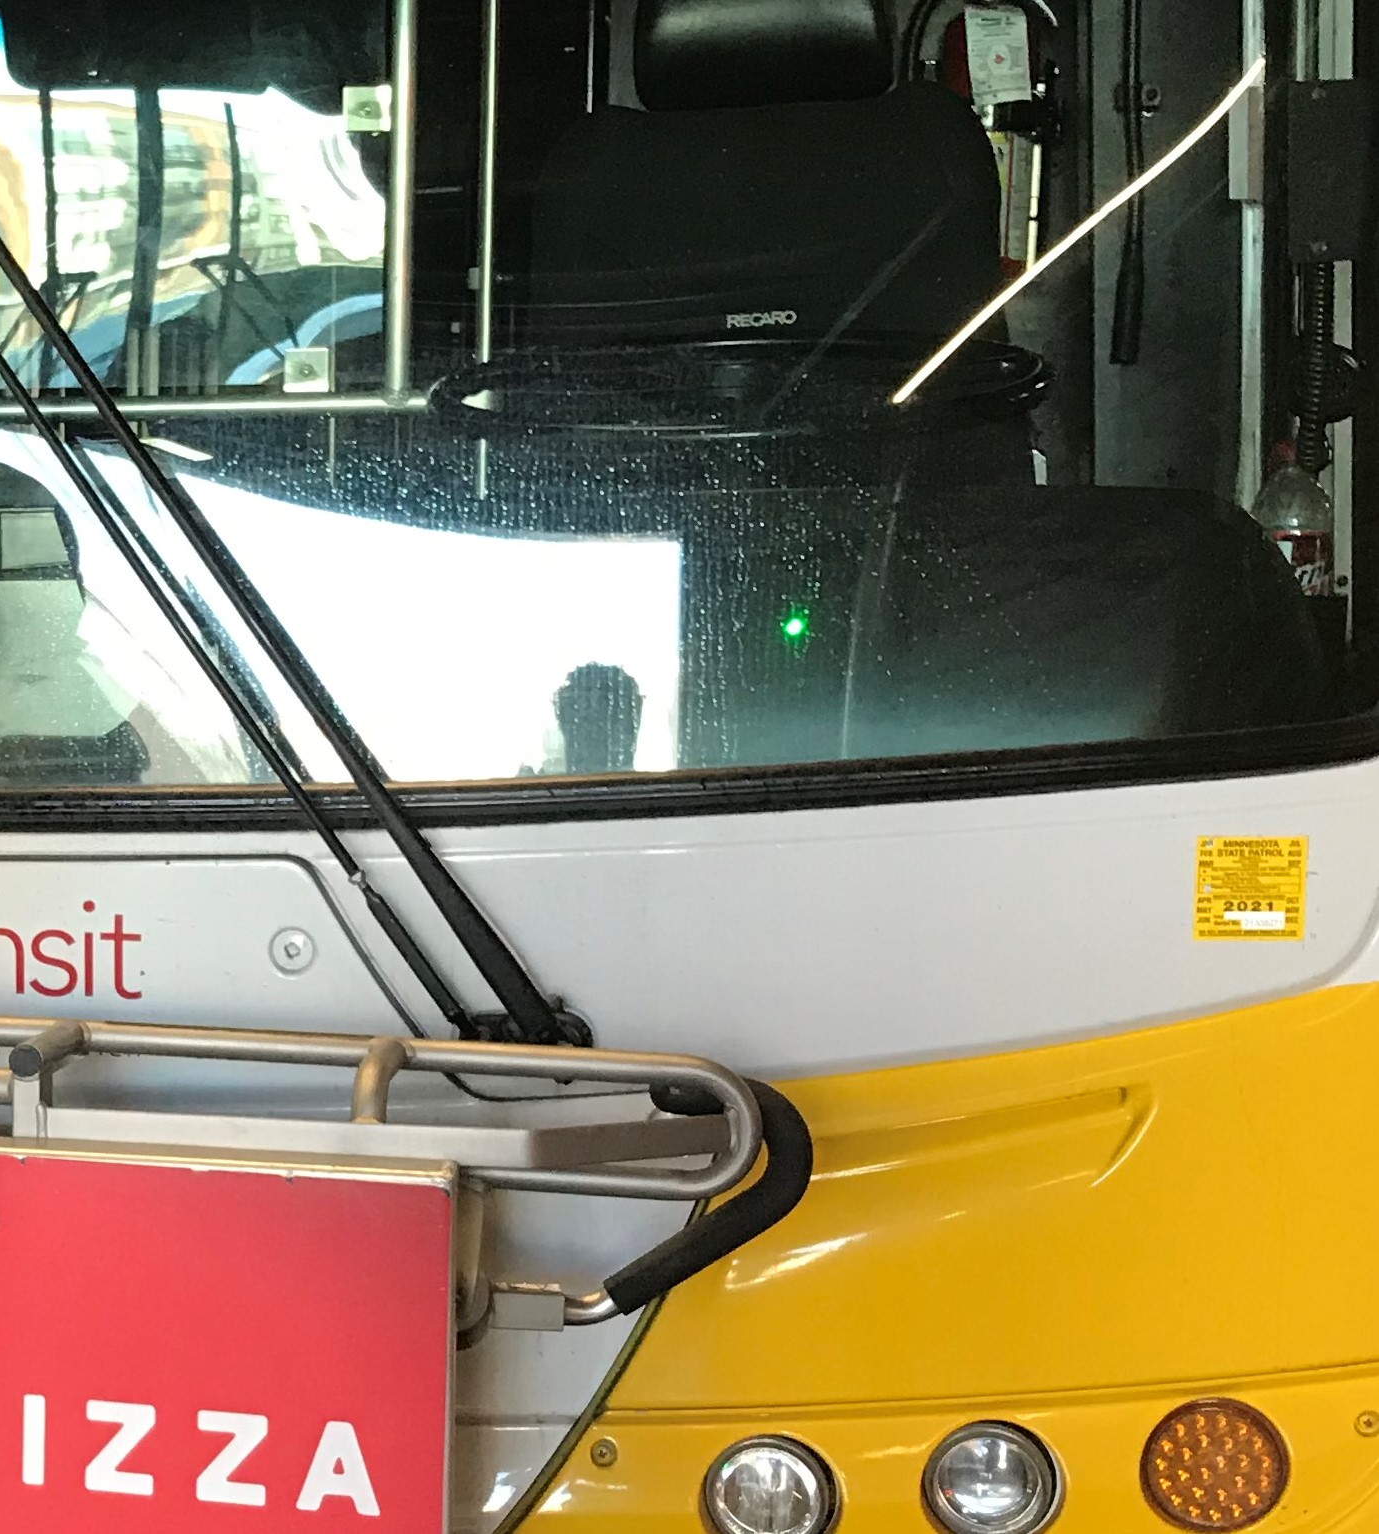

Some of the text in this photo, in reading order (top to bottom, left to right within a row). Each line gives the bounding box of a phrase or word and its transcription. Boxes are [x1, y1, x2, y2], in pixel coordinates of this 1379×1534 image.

[726, 310, 797, 328] RECARO
[1223, 839, 1280, 848] MINNESOTA
[1217, 849, 1285, 857] STATE PATROL
[1223, 900, 1274, 912] 2021
